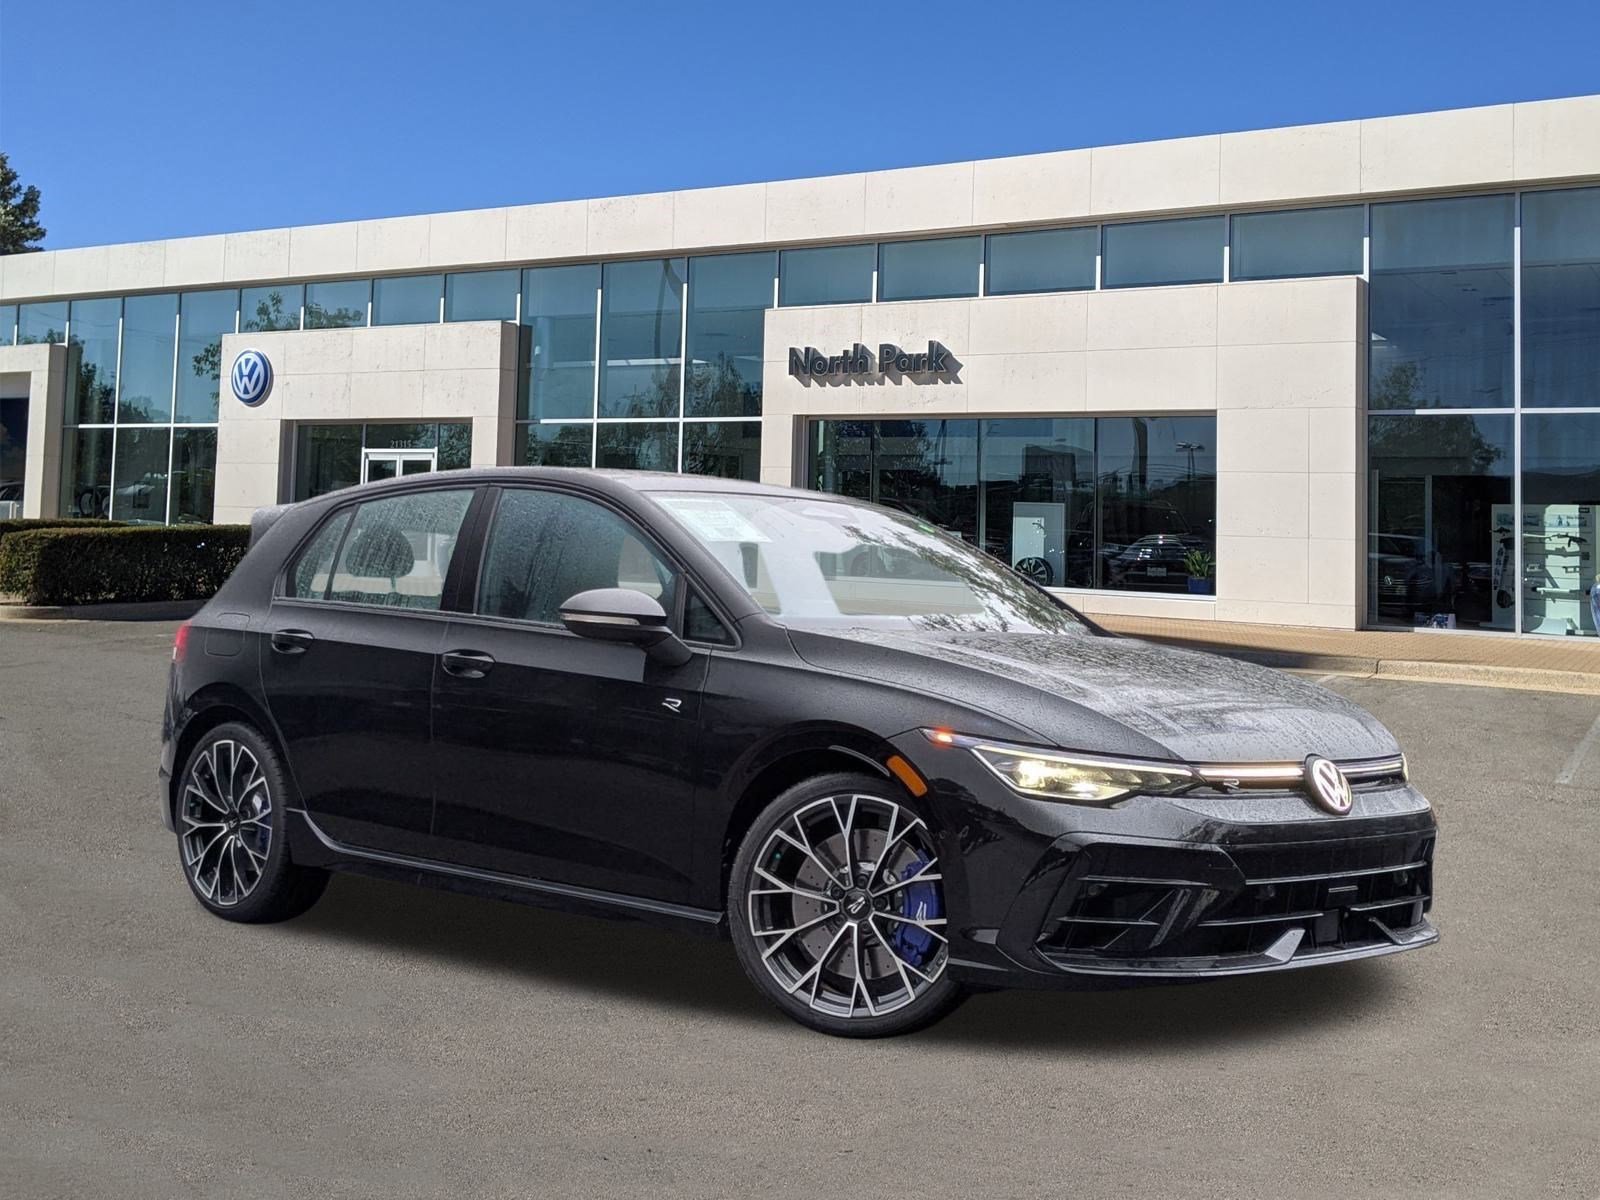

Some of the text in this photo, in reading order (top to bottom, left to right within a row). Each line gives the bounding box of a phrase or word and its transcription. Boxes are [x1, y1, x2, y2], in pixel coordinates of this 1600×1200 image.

[233, 351, 267, 402] VW
[788, 340, 950, 377] North Park
[1311, 757, 1353, 814] VW
